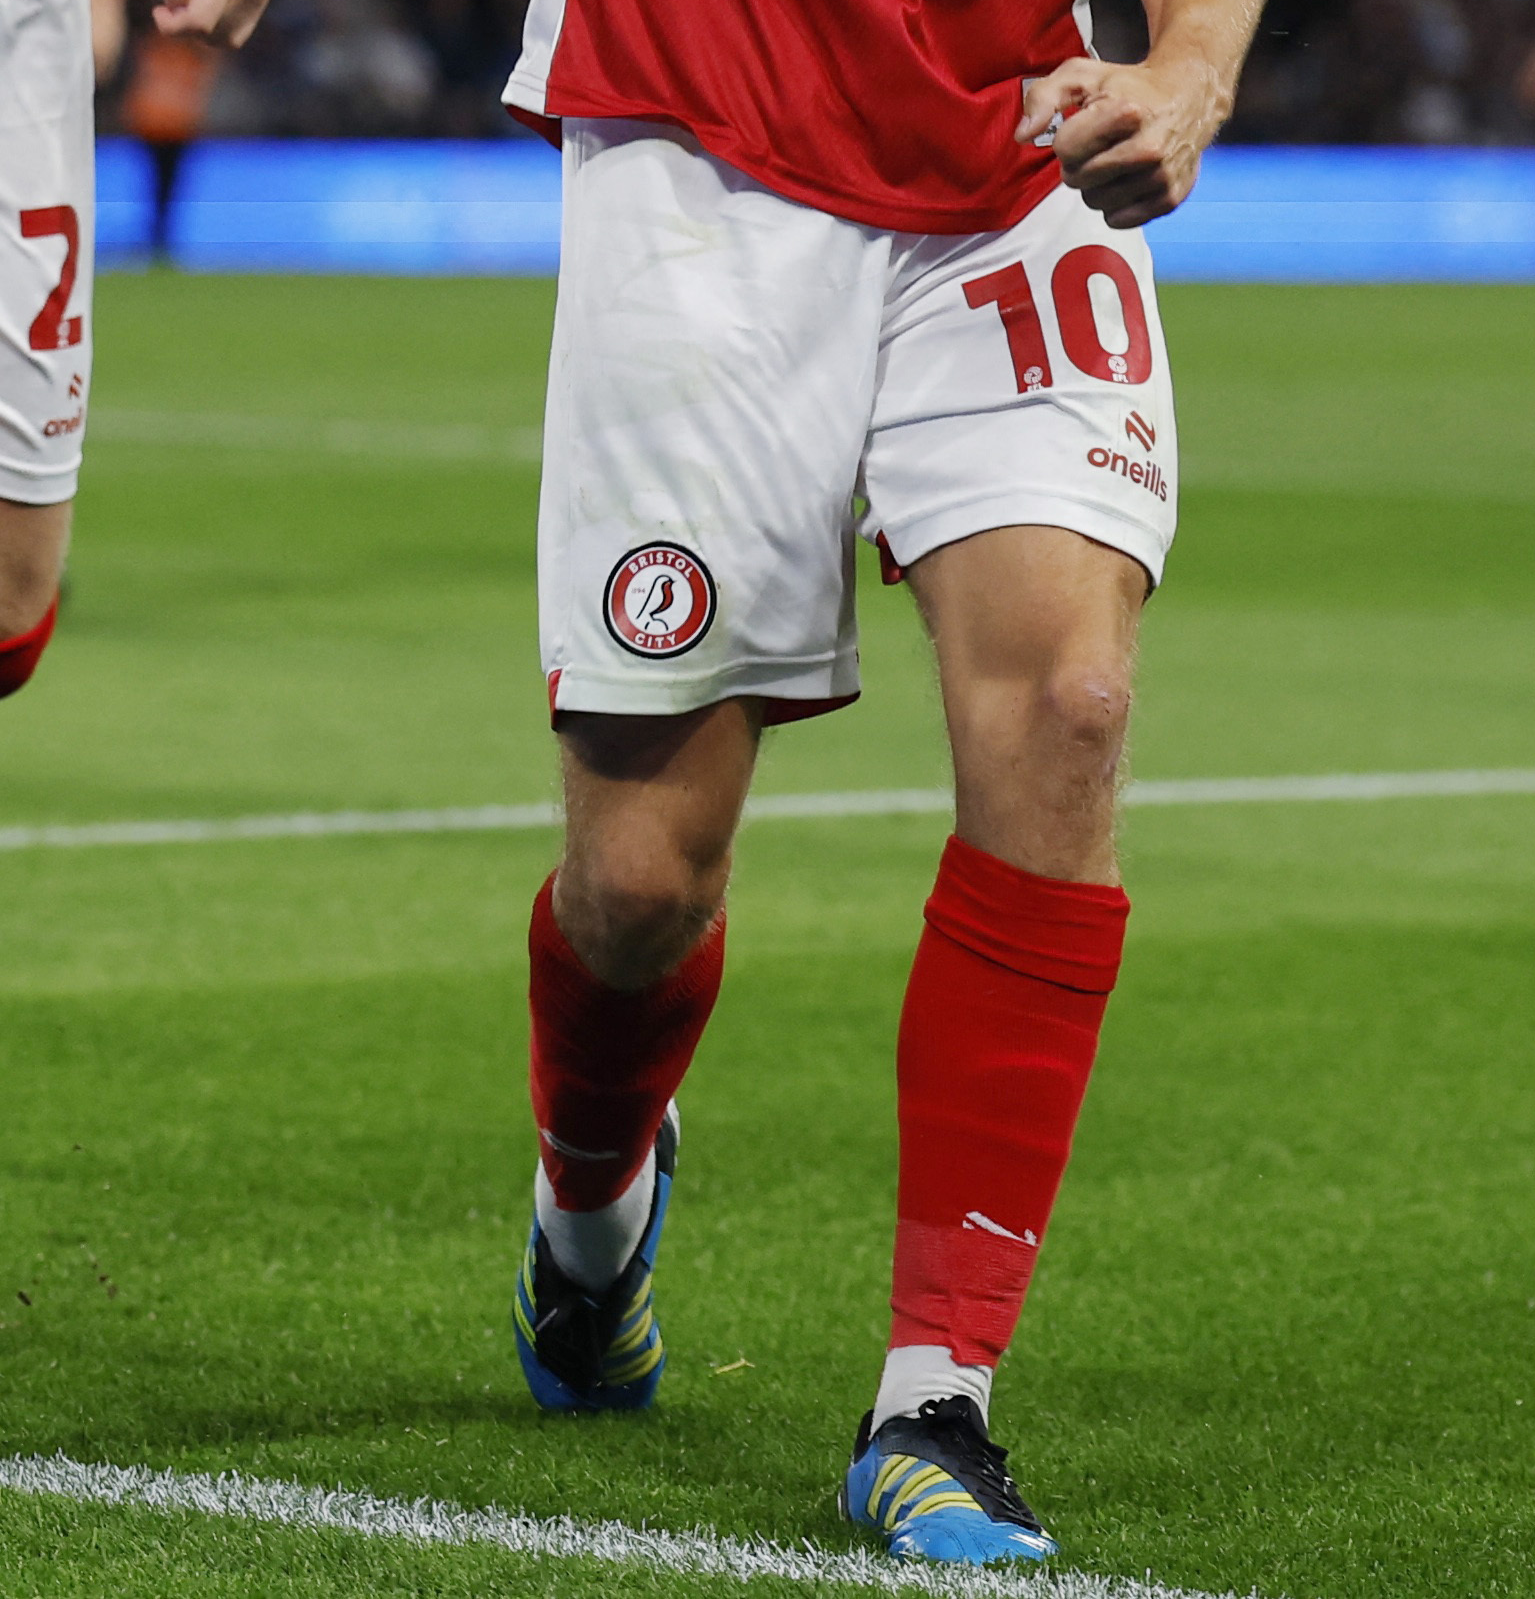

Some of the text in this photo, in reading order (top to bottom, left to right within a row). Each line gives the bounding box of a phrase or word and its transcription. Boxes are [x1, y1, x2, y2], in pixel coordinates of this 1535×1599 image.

[20, 205, 82, 351] 2
[961, 244, 1153, 394] 10
[628, 551, 695, 579] BRISTOL
[634, 632, 677, 649] CITY
